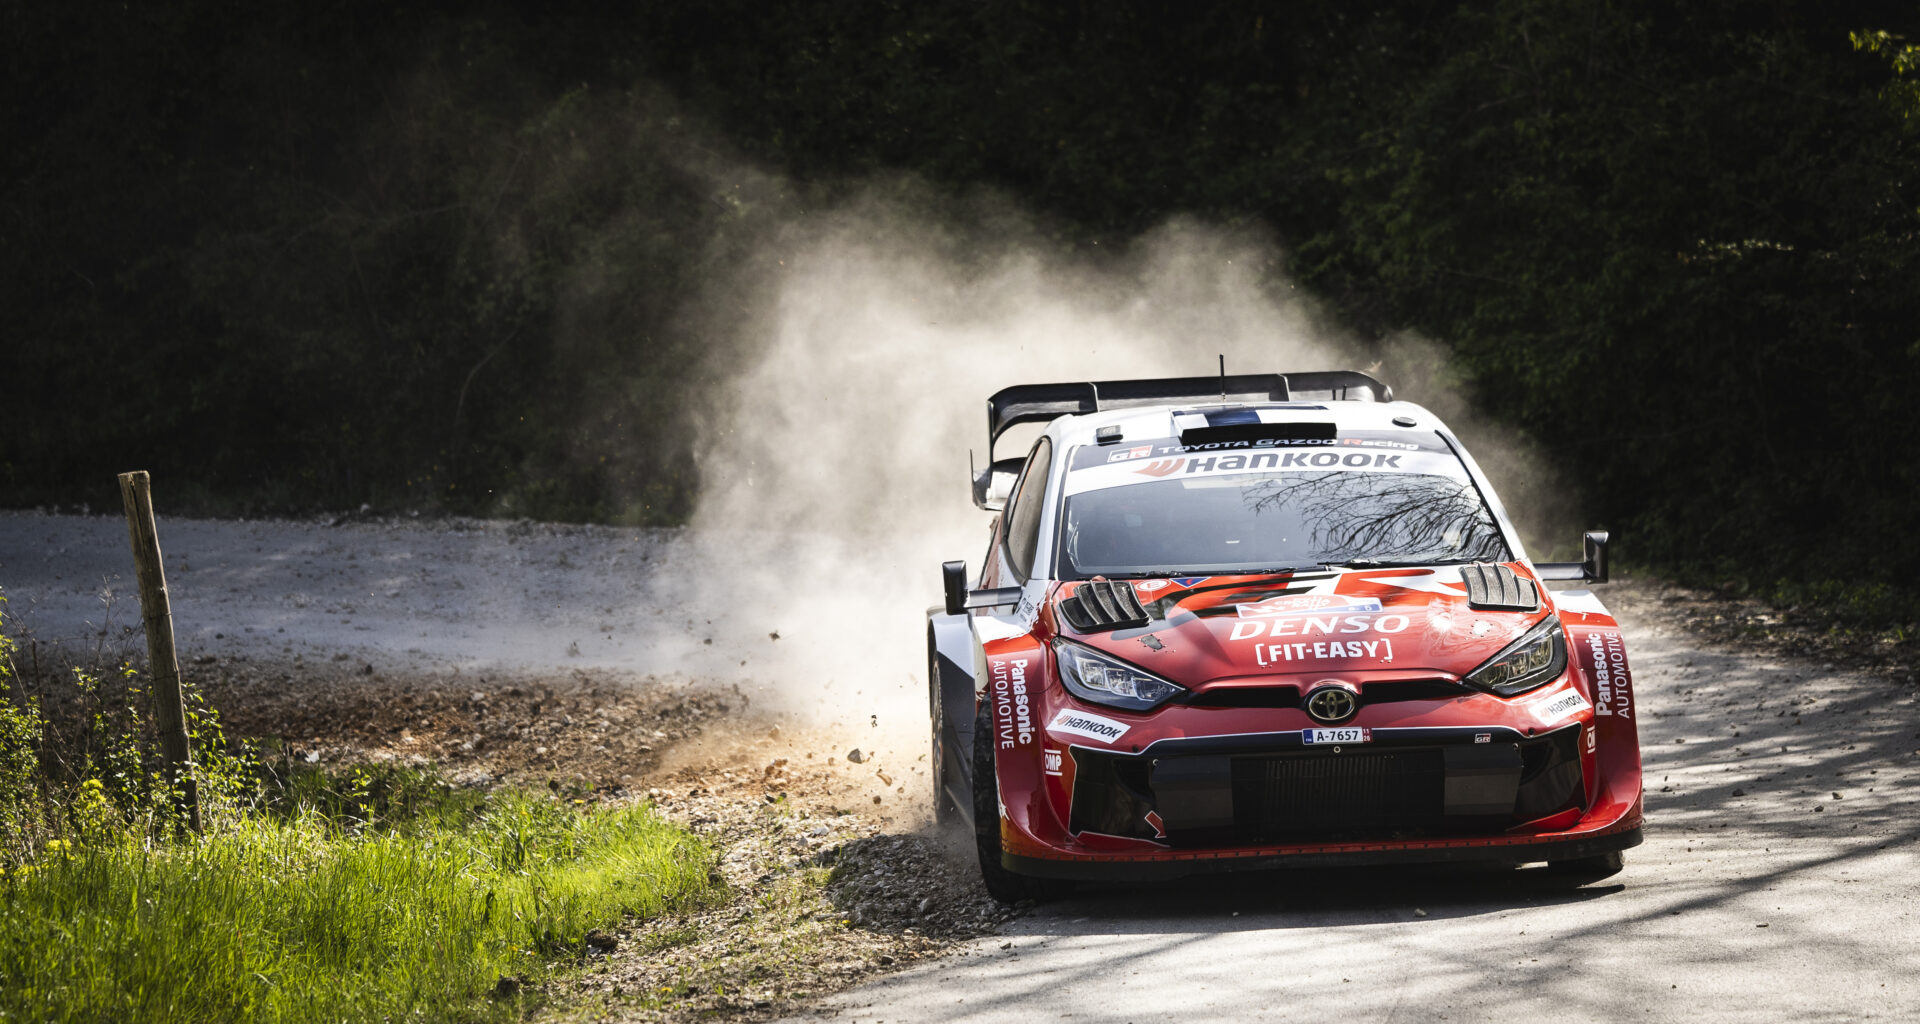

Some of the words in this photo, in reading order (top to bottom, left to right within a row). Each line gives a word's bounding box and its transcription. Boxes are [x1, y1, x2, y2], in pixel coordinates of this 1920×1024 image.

[1109, 447, 1150, 461] GR
[1158, 440, 1249, 454] TOYOTA
[1256, 438, 1338, 446] GAZOO
[1229, 615, 1410, 641] DENSO
[1010, 658, 1036, 745] Panasonic
[1585, 633, 1613, 716] Panasonic
[1604, 632, 1630, 719] AUTOMOTIVE
[993, 660, 1014, 750] AUTOMOTIVE
[1045, 753, 1062, 772] OMP
[1317, 730, 1359, 742] A-7657
